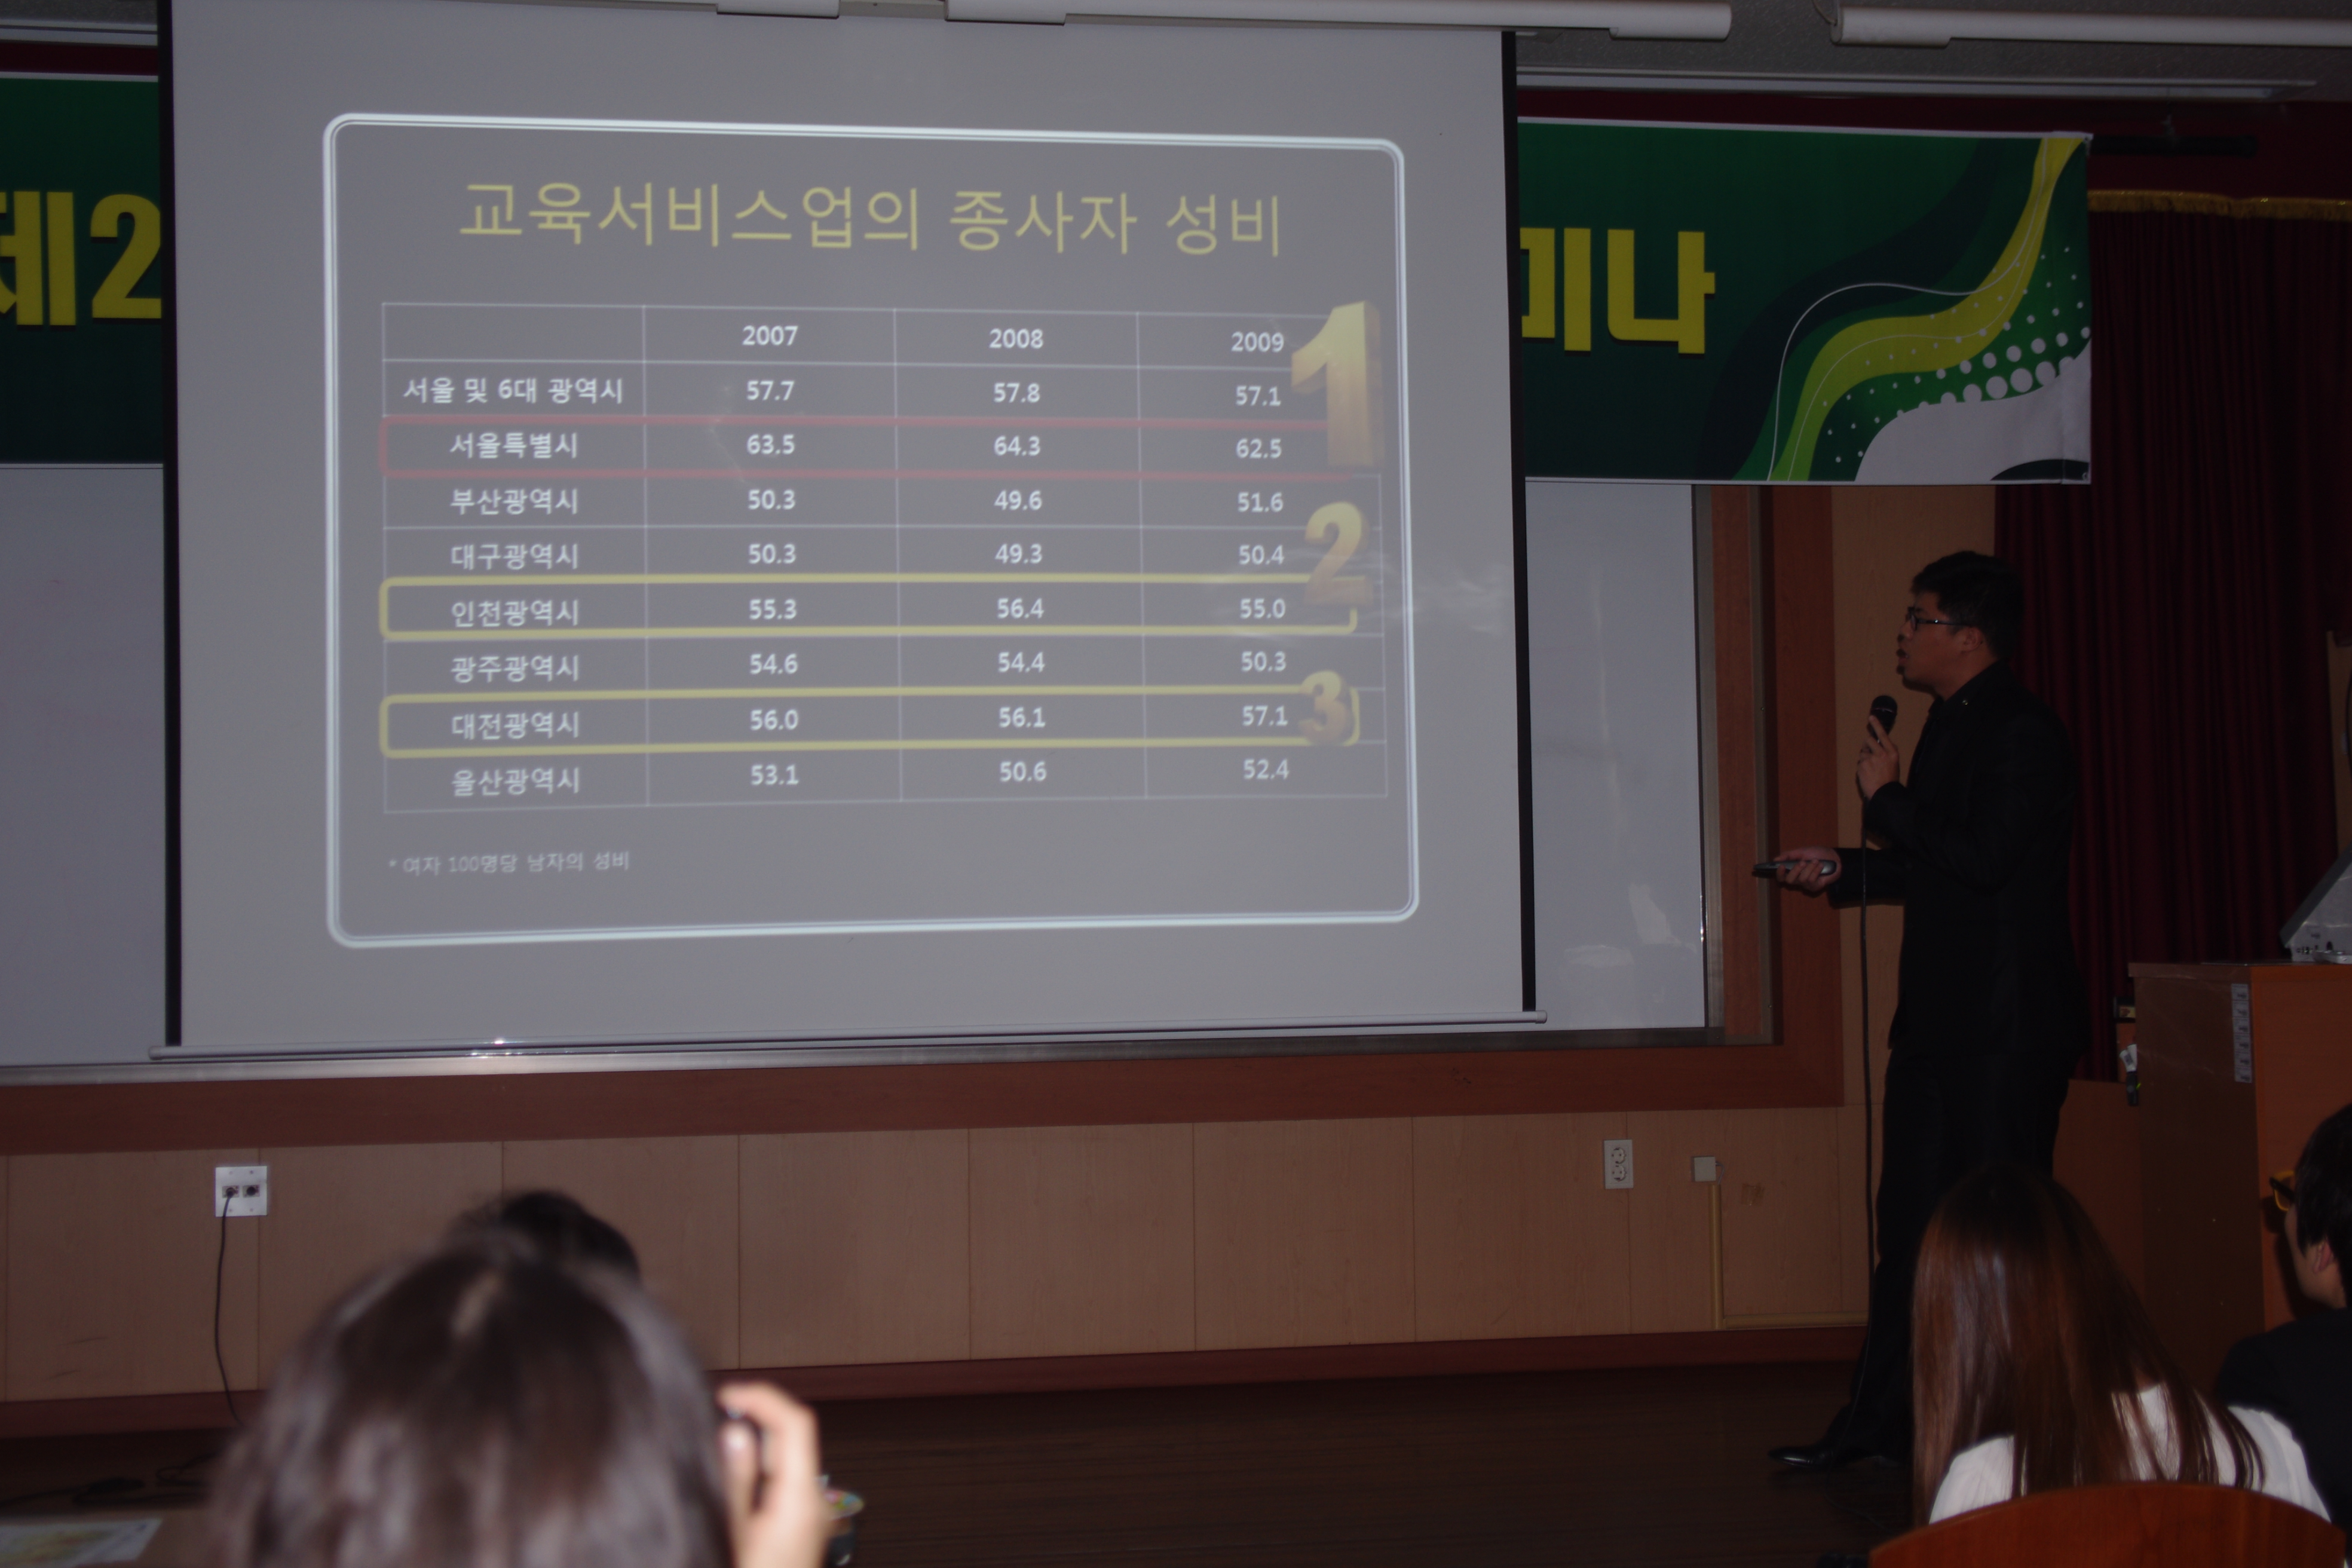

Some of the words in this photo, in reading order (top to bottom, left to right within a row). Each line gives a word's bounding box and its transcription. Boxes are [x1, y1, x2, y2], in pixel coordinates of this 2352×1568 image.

[460, 182, 918, 248] 교육서비스업의
[950, 191, 1138, 254] 종사자
[1166, 194, 1279, 256] 성비
[743, 325, 798, 345] 2007
[990, 328, 1043, 349] 2008
[1232, 332, 1284, 353] 2009
[405, 377, 455, 403] 서울
[465, 378, 486, 403] 및
[498, 378, 537, 403] 6대
[549, 378, 622, 404] 광역시
[748, 380, 795, 400] 57.7
[994, 382, 1040, 403] 57.8
[1236, 385, 1281, 406] 57.1
[1291, 301, 1382, 467] 1
[451, 432, 577, 459] 서울특별시
[747, 434, 795, 455] 63.5
[994, 436, 1040, 456] 64.3
[1236, 438, 1282, 458] 62.5
[451, 488, 577, 515] 부산광역시
[749, 489, 795, 510] 50.3
[994, 490, 1042, 510] 49.6
[1238, 492, 1284, 512] 51.6
[452, 543, 578, 570] 대구광역시
[749, 543, 796, 564] 50.3
[996, 543, 1042, 564] 49.3
[1239, 544, 1285, 565] 50.4
[1304, 501, 1372, 605] 2
[452, 600, 579, 627] 인천광역시
[750, 599, 797, 620] 55.3
[998, 598, 1044, 618] 56.4
[1241, 598, 1286, 618] 55.0
[452, 655, 578, 683] 광주광역시
[751, 653, 798, 674] 54.6
[999, 651, 1045, 672] 54.4
[1242, 651, 1286, 672] 50.3
[453, 712, 578, 740] 대전광역시
[751, 709, 798, 730] 56.0
[1000, 706, 1046, 728] 56.1
[1243, 705, 1288, 726] 57.1
[1298, 670, 1352, 746] 3
[453, 767, 579, 797] 울산광역시
[752, 764, 799, 785] 53.1
[1000, 761, 1047, 782] 50.6
[1244, 758, 1289, 779] 52.4
[404, 856, 441, 875] 여자
[449, 854, 517, 873] 100명당
[528, 852, 583, 872] 남자의
[595, 852, 629, 870] 성비
